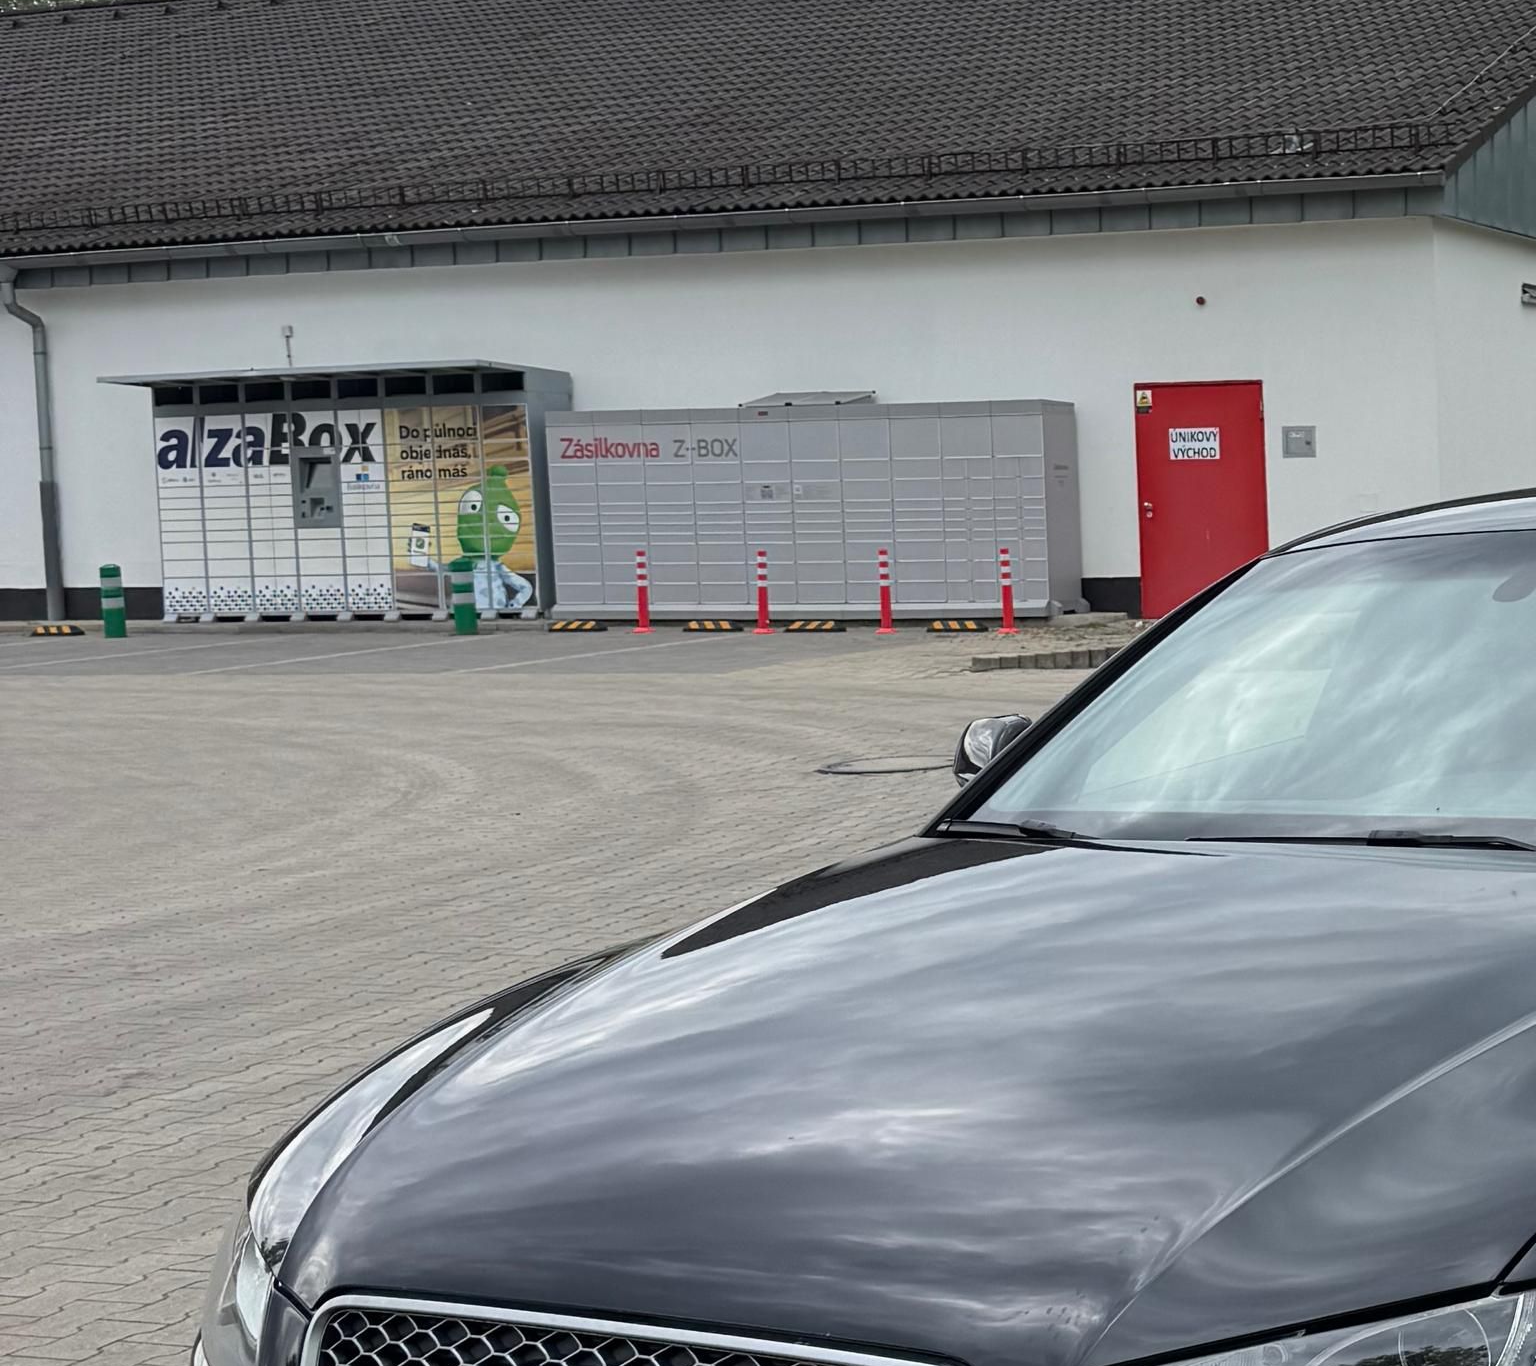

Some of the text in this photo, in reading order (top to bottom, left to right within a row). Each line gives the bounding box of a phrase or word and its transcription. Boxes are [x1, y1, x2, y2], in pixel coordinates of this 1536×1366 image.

[399, 425, 420, 440] Do
[1171, 427, 1218, 443] ÚNIKOVÝ
[560, 437, 660, 460] Zásilkovna
[1172, 445, 1217, 459] VÝCHOD
[401, 461, 468, 481] ráno máš
